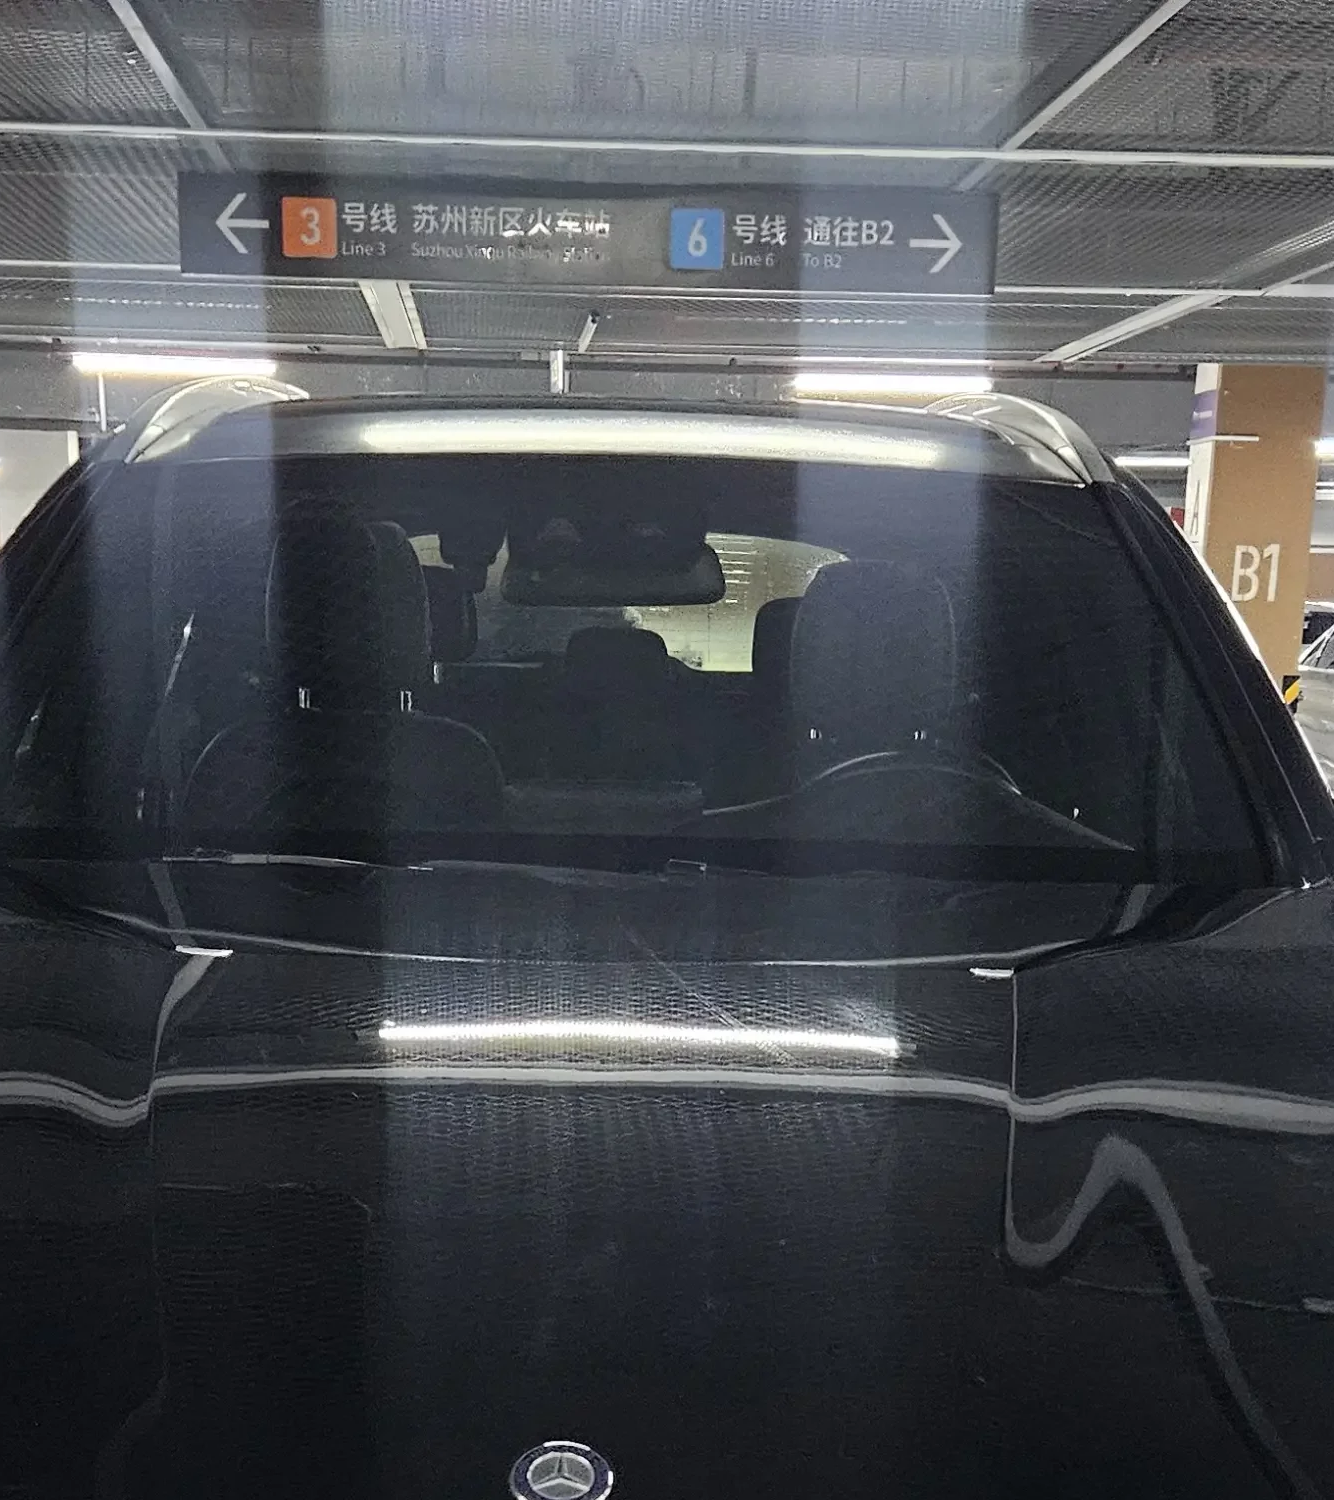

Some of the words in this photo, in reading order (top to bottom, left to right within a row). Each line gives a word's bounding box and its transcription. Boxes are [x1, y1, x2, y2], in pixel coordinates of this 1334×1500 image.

[300, 206, 322, 246] 3
[341, 203, 398, 235] 号线
[411, 205, 611, 240] 苏州新区火车站
[687, 217, 709, 257] 6
[731, 214, 788, 246] 号线
[803, 216, 896, 247] 通往B2
[342, 242, 373, 257] Line
[378, 243, 387, 257] 3
[411, 241, 463, 258] Suzhou
[731, 252, 764, 267] Line
[765, 253, 775, 267] 6
[803, 253, 820, 268] To
[823, 253, 843, 269] B2
[1230, 543, 1281, 603] B1
